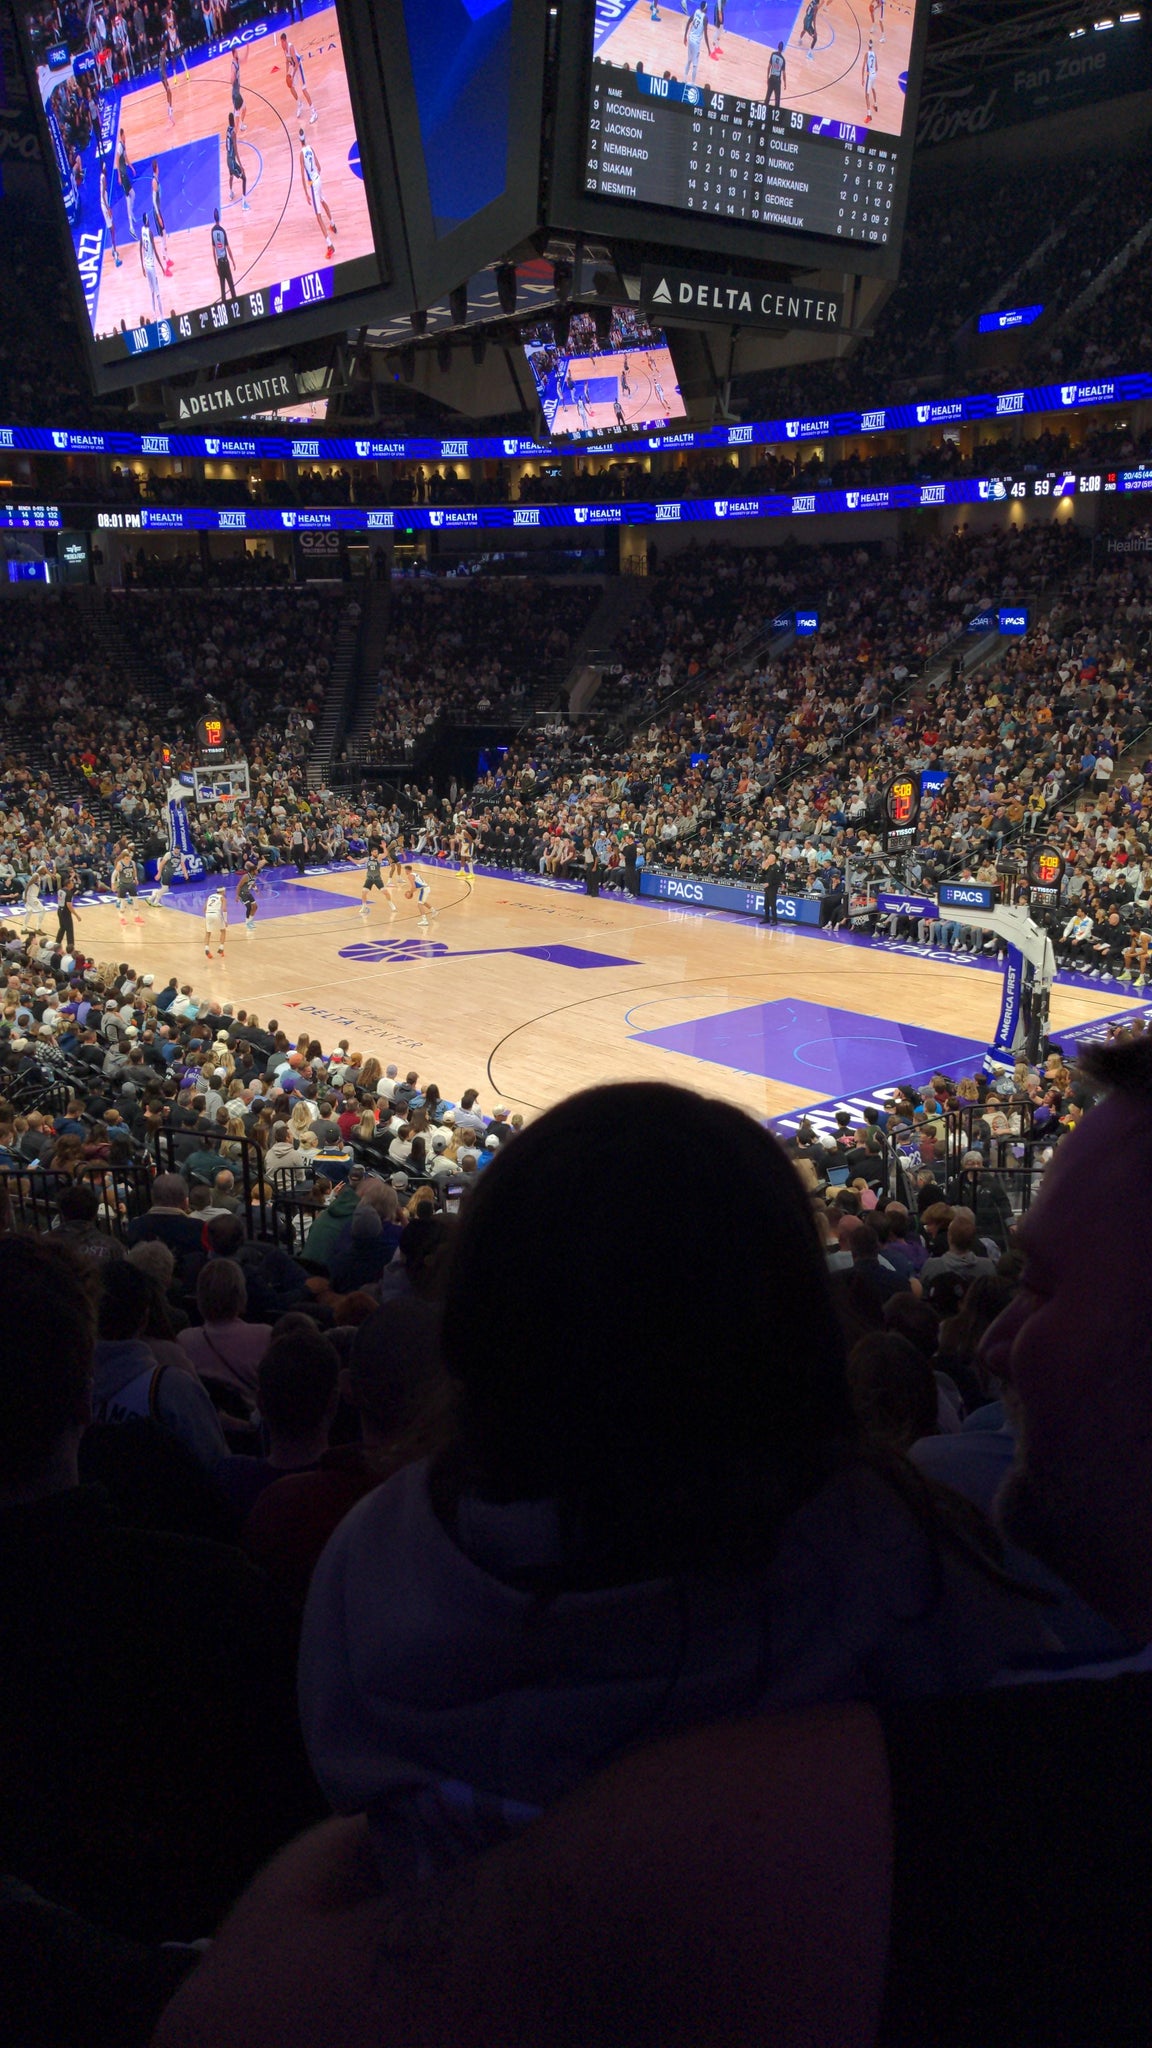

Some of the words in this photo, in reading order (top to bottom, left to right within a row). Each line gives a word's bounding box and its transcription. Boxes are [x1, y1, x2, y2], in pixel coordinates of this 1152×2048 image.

[218, 23, 268, 53] PACS
[1014, 68, 1050, 93] Fan
[1055, 53, 1107, 81] Zone
[608, 88, 622, 98] NAME
[650, 77, 668, 97] IND
[710, 94, 724, 111] 45
[750, 102, 767, 120] 5:08
[772, 110, 780, 121] 12
[790, 112, 803, 130] 59
[839, 123, 856, 141] UTA
[101, 104, 112, 139] HEALTH
[594, 100, 599, 110] 9
[606, 102, 655, 122] MCCONNELL
[692, 122, 700, 133] 10
[732, 131, 742, 142] 07
[591, 119, 600, 130] 22
[605, 123, 642, 139] JACKSON
[692, 142, 698, 151] 2
[707, 144, 712, 154] 2
[719, 147, 724, 157] 0
[730, 150, 740, 160] 05
[745, 153, 750, 162] 2
[591, 140, 597, 149] 2
[603, 142, 648, 160] NEMBHARD
[689, 160, 698, 170] 10
[705, 163, 711, 173] 2
[730, 168, 738, 178] 10
[744, 171, 748, 180] 2
[759, 137, 765, 147] 8
[770, 140, 798, 154] COLLIER
[844, 156, 849, 165] 5
[857, 159, 862, 168] 3
[868, 162, 873, 170] 5
[877, 163, 886, 173] 07
[588, 159, 598, 170] 43
[602, 162, 633, 177] SIAKAM
[688, 179, 696, 189] 14
[704, 182, 709, 191] 3
[716, 184, 721, 194] 3
[728, 186, 736, 197] 13
[756, 154, 765, 165] 30
[768, 157, 794, 171] NURKIC
[843, 174, 848, 182] 7
[855, 176, 860, 185] 6
[876, 181, 883, 190] 12
[888, 184, 893, 192] 2
[587, 179, 597, 189] 23
[601, 181, 636, 197] NESMITH
[688, 197, 693, 207] 3
[702, 200, 708, 210] 2
[714, 202, 720, 212] 4
[727, 205, 734, 214] 14
[754, 173, 763, 183] 23
[766, 176, 809, 193] MARKKANEN
[840, 191, 847, 200] 12
[853, 193, 858, 202] 0
[874, 198, 880, 207] 12
[886, 200, 891, 208] 0
[754, 191, 759, 201] 3
[765, 194, 794, 208] GEORGE
[838, 208, 844, 217] 0
[851, 210, 856, 220] 2
[862, 213, 867, 221] 3
[871, 214, 880, 224] 09
[884, 217, 889, 226] 2
[751, 209, 759, 219] 10
[763, 212, 804, 227] MYKHAILIUK
[837, 225, 842, 234] 6
[869, 231, 878, 240] 09
[882, 233, 887, 242] 0
[78, 229, 103, 288] JAZZ
[132, 328, 149, 350] IND
[180, 315, 191, 337] 45
[211, 303, 228, 328] 5:08
[231, 302, 240, 318] 12
[249, 292, 264, 316] 59
[301, 273, 324, 300] UTA
[679, 282, 752, 312] DELTA
[761, 293, 837, 322] CENTER
[190, 389, 234, 415] DELTA
[236, 376, 289, 404] CENTER
[1079, 384, 1114, 397] HEALTH
[932, 404, 962, 415] HEALTH
[801, 422, 829, 431] HEALTH
[70, 435, 104, 445] HEALTH
[222, 442, 255, 450] HEALTH
[372, 444, 404, 452] HEALTH
[1108, 473, 1116, 482] 12
[1124, 472, 1142, 480] 20/45
[1011, 482, 1025, 497] 45
[1034, 481, 1049, 495] 59
[1080, 476, 1100, 492] 5:08
[98, 513, 123, 527] 08:01
[125, 514, 140, 527] PM
[446, 513, 478, 521] HEALTH
[590, 509, 621, 518] HEALTH
[300, 531, 340, 547] G2G
[1005, 617, 1025, 625] PACS
[208, 730, 221, 744] 12
[894, 784, 912, 798] 5:08
[895, 797, 910, 819] 12
[896, 827, 916, 836] TISSOT
[1040, 855, 1058, 868] 5:08
[1041, 867, 1055, 880] 12
[668, 881, 703, 900] PACS
[954, 891, 983, 903] PACS
[755, 896, 796, 916] PCS
[888, 944, 978, 963] PACS
[1006, 966, 1016, 995] FIRST
[1000, 992, 1014, 1041] AMERICA
[300, 1006, 355, 1026] DELTA
[354, 1024, 424, 1049] CENTER
